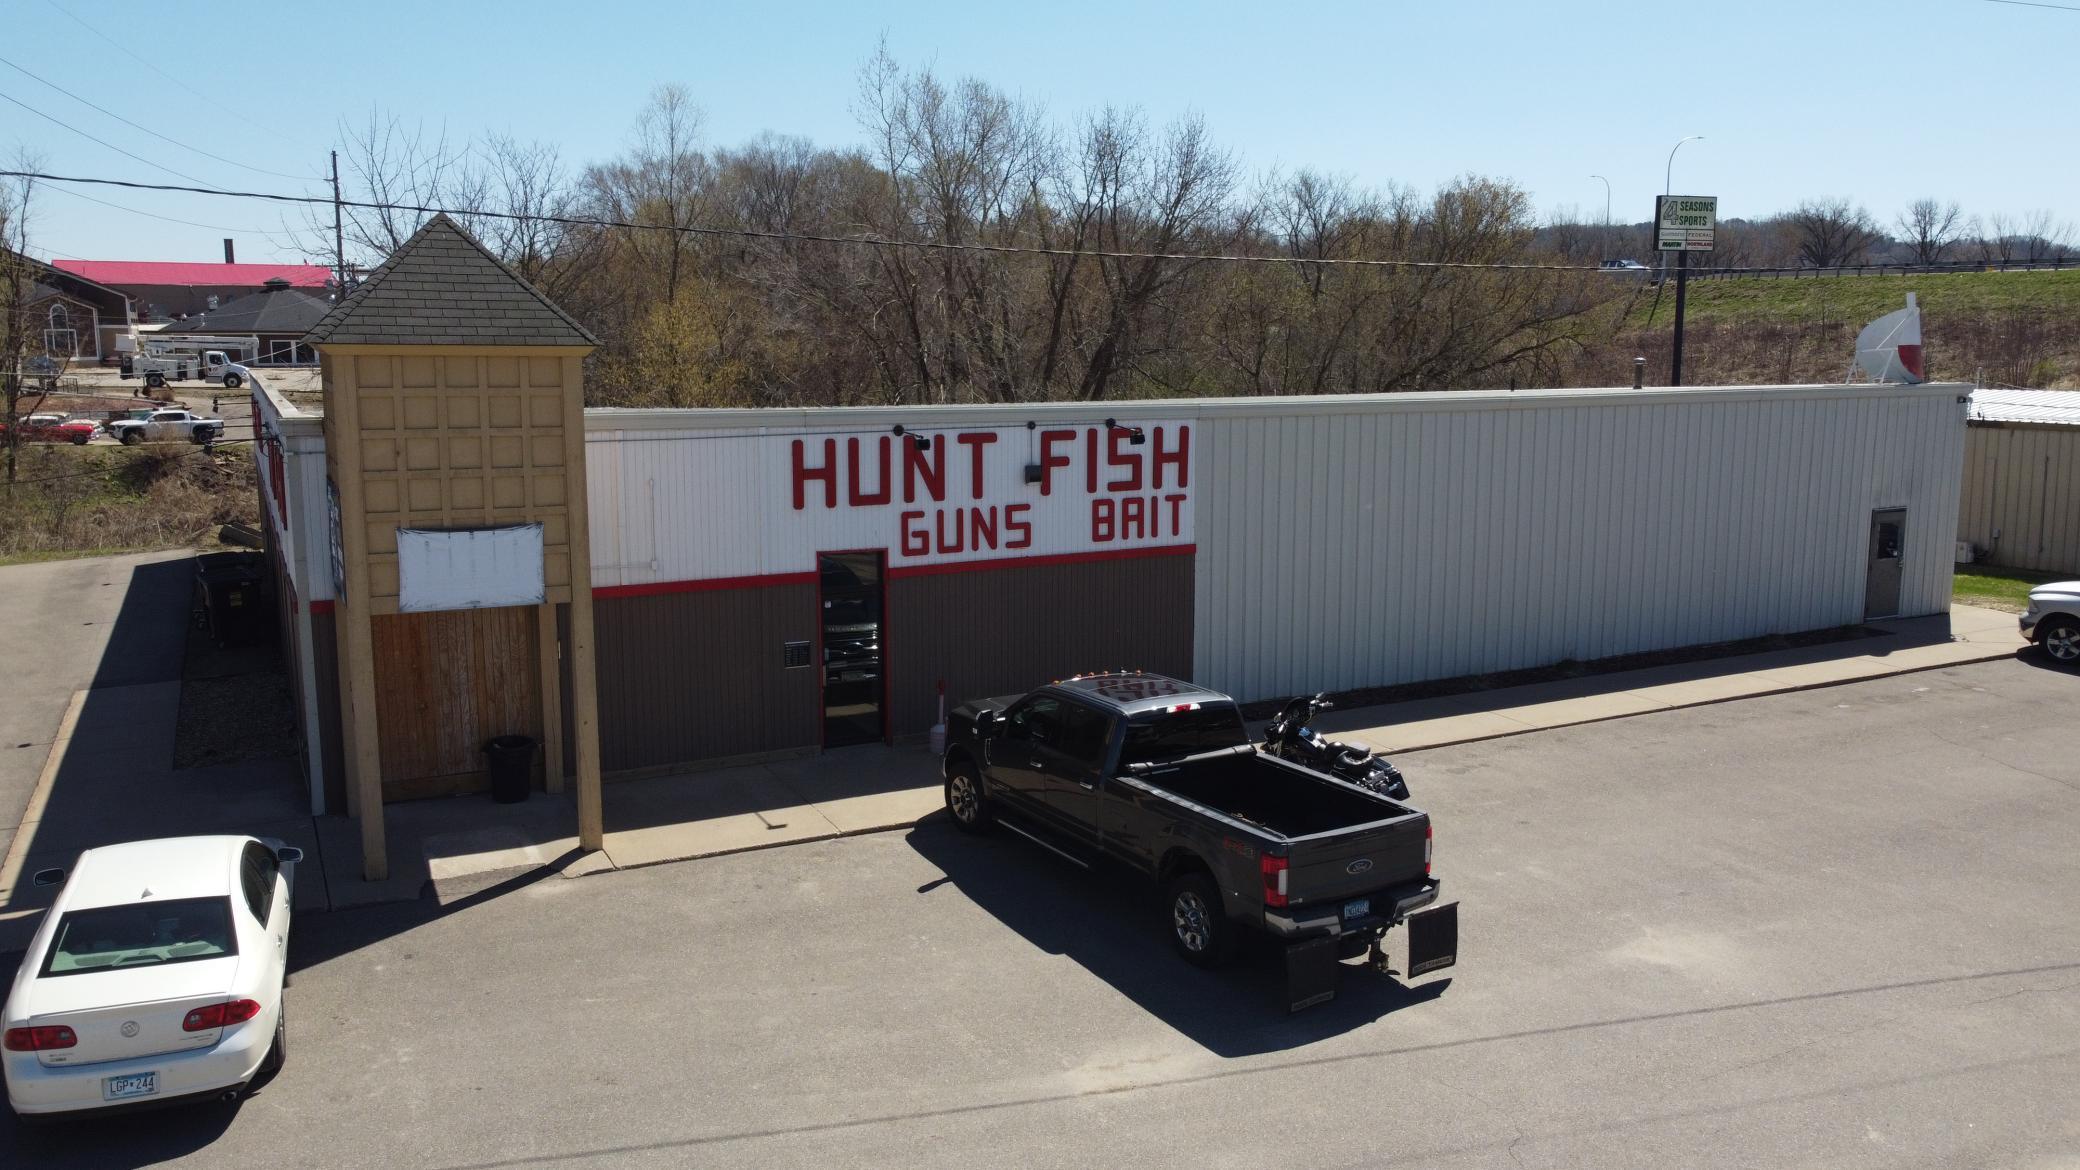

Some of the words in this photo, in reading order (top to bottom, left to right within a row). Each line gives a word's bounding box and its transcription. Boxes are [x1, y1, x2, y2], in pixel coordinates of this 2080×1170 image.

[1663, 201, 1679, 225] 4
[1680, 201, 1714, 212] SEASONS
[1679, 215, 1707, 226] SPORTS
[792, 433, 998, 510] HUNT
[1040, 426, 1190, 496] FISH
[901, 504, 1031, 556] GUNS
[1092, 494, 1187, 542] BAIT
